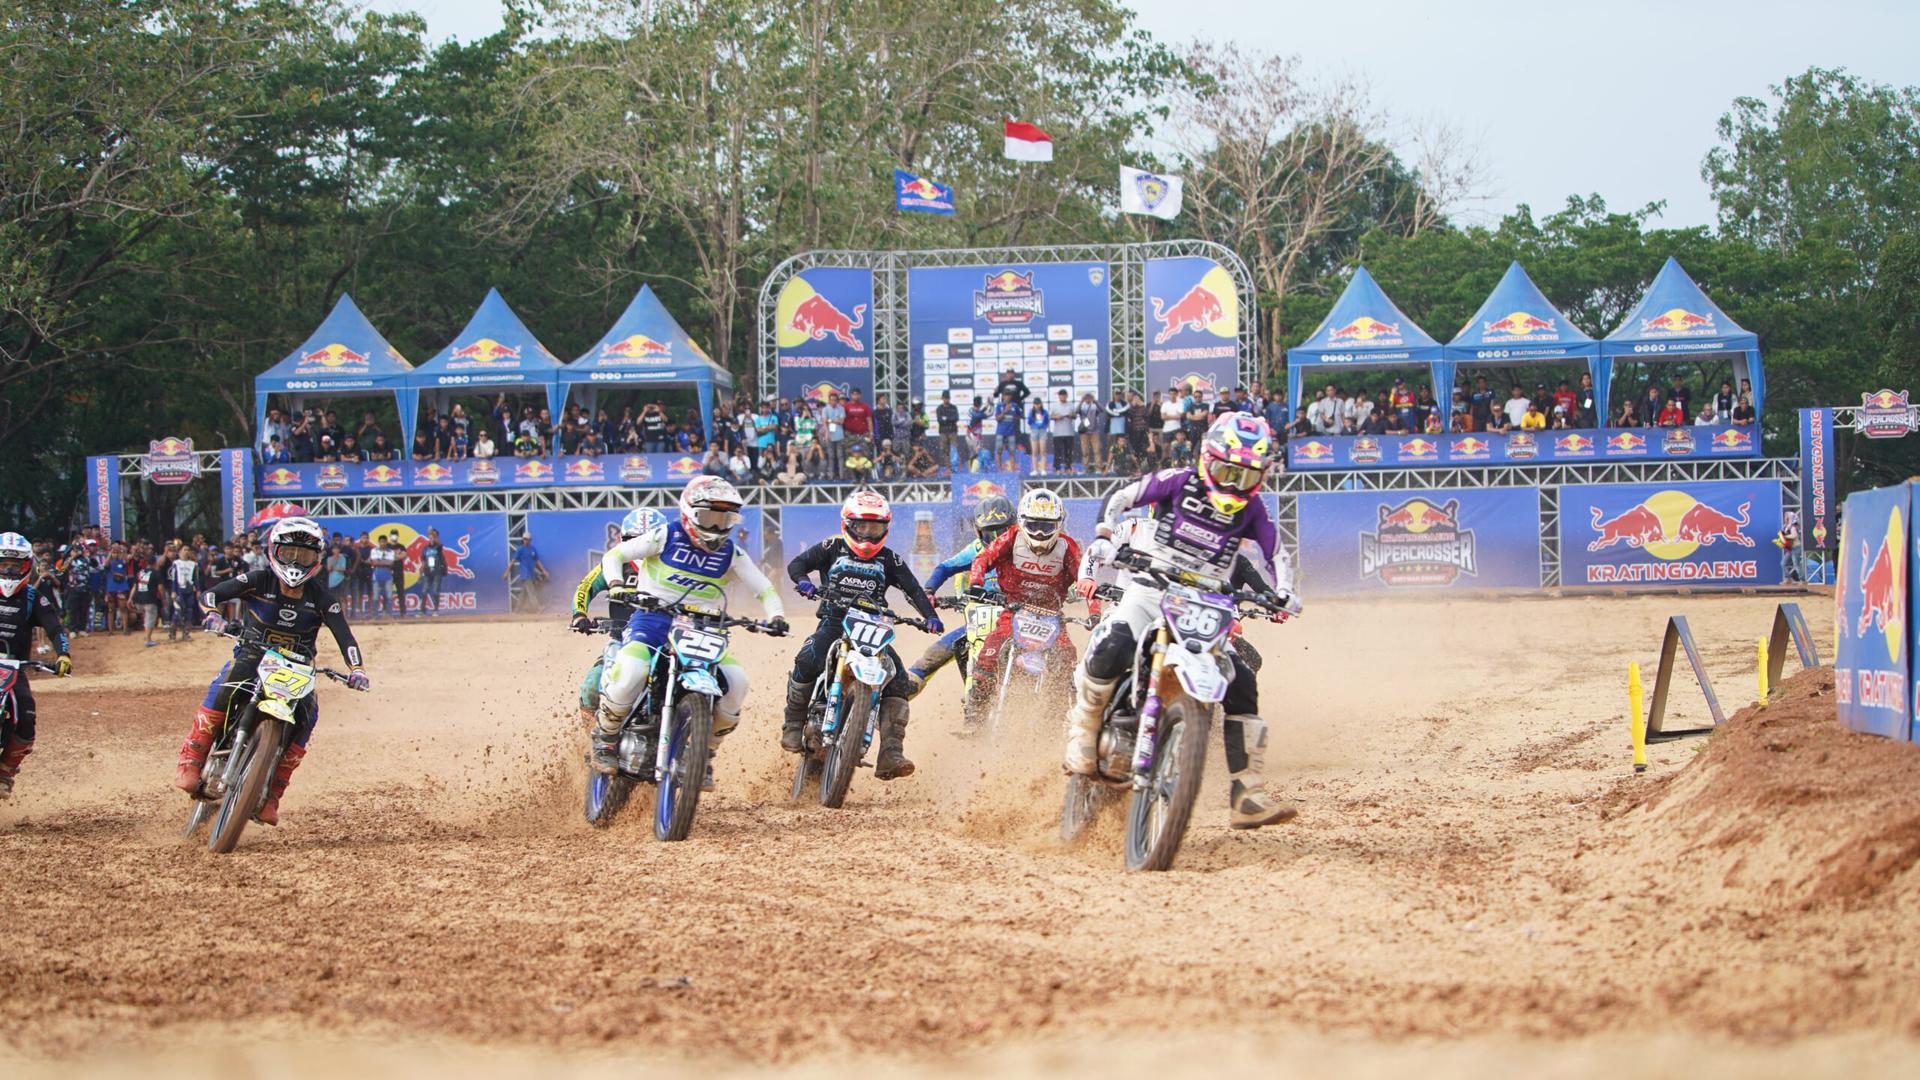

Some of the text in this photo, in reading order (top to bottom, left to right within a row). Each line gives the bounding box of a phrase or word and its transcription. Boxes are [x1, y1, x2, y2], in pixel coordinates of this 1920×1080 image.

[1810, 409, 1825, 516] KRATINGDAENG
[232, 450, 245, 533] ATINGDAENG
[672, 548, 723, 571] ONE
[1021, 561, 1056, 573] ONE
[1363, 540, 1473, 574] SUPERCROSSER
[1587, 561, 1757, 583] KRATINGDAENG
[850, 621, 888, 646] 111
[1020, 622, 1051, 638] 202
[678, 630, 724, 660] 25
[264, 667, 311, 696] 27
